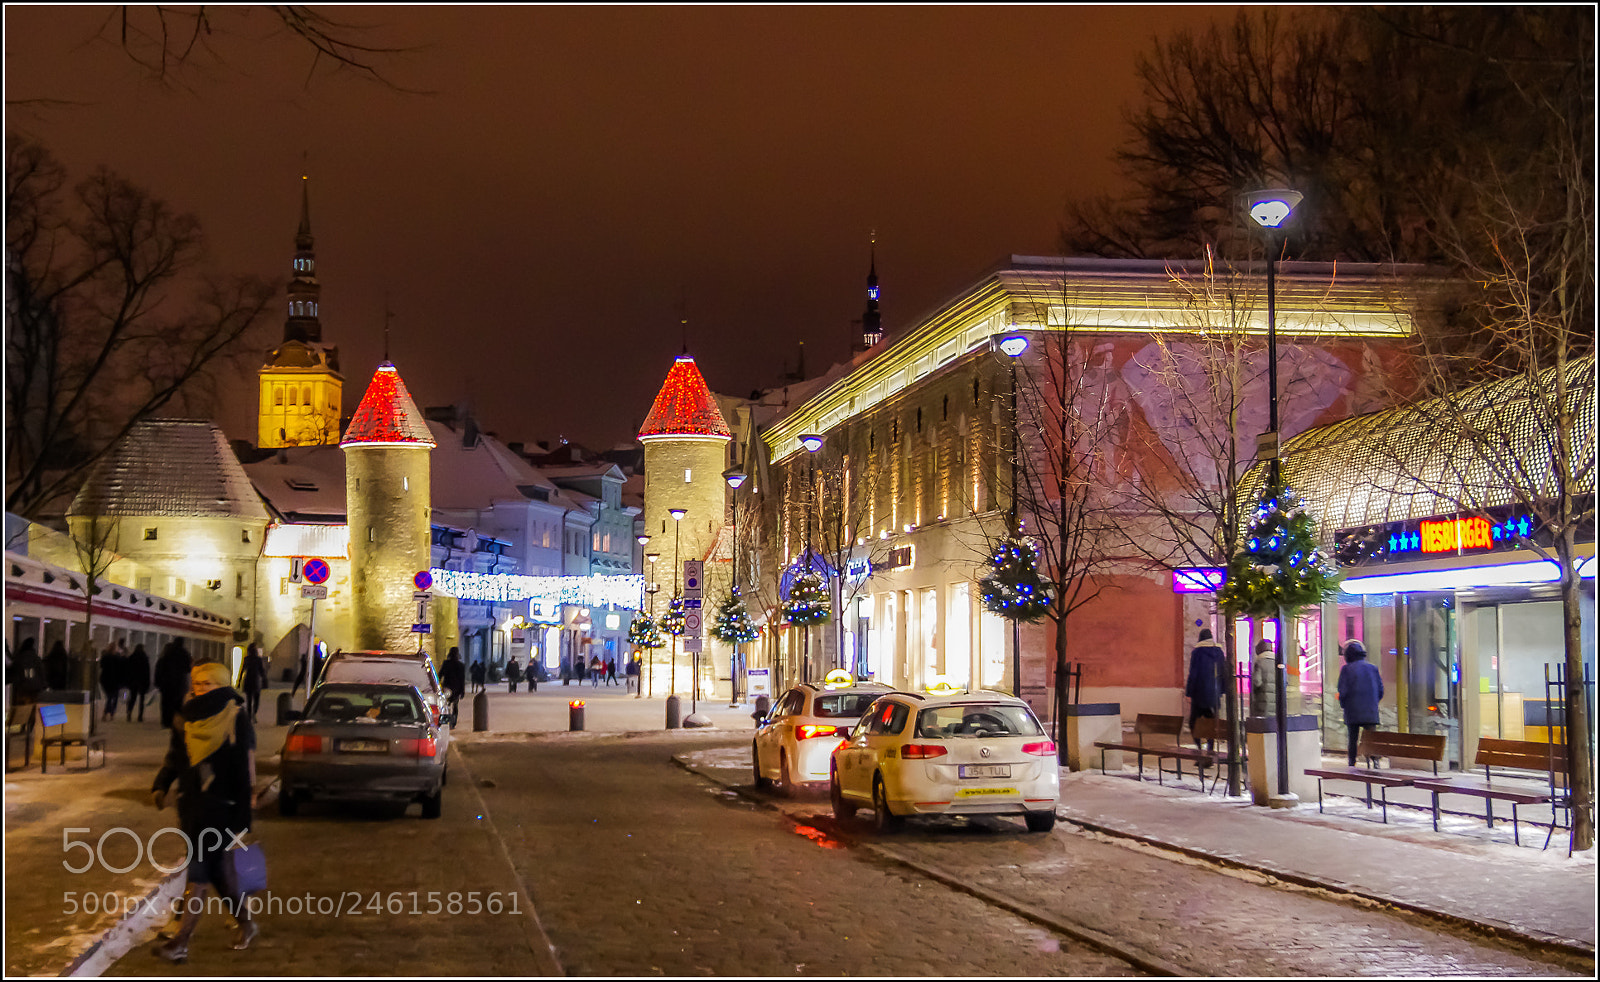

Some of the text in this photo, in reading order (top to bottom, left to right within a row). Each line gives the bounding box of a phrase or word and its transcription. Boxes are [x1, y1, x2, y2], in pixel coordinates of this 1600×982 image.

[1420, 517, 1492, 552] HESBURGER
[968, 767, 1007, 776] 354 TUL
